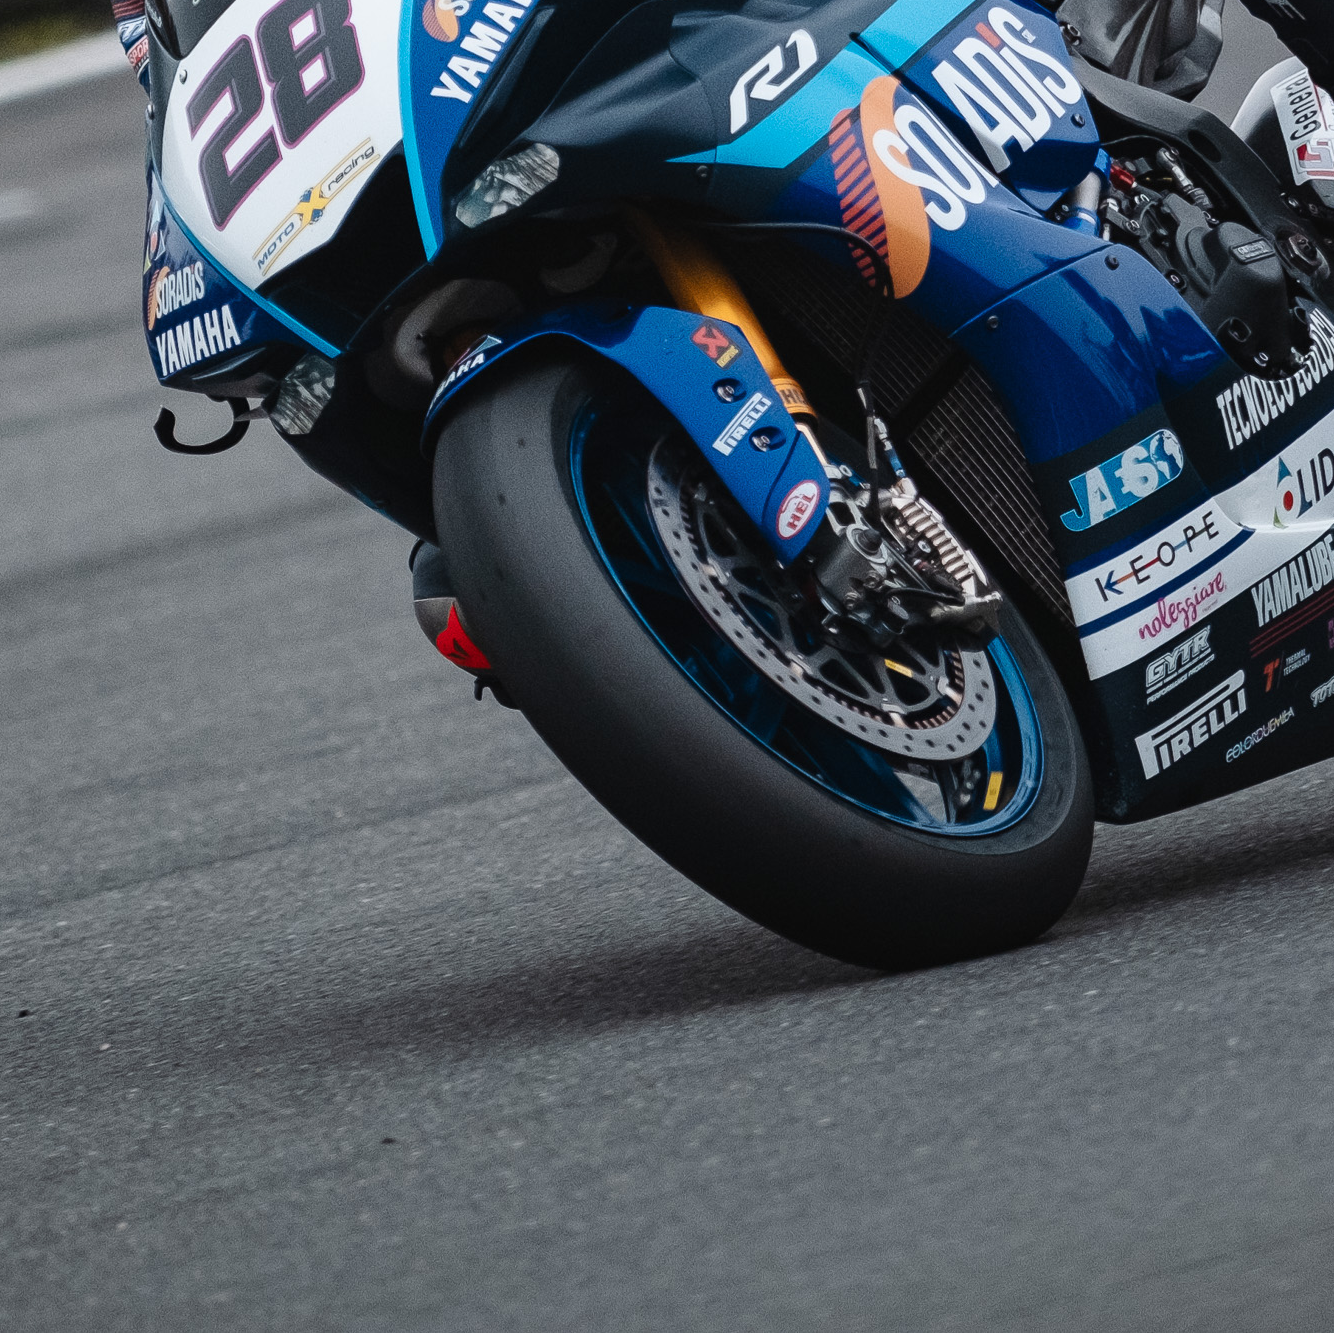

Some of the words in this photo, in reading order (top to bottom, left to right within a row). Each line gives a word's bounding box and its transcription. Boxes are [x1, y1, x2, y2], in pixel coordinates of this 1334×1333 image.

[257, 221, 295, 270] MOTO
[328, 146, 375, 192] racing
[155, 303, 241, 377] YAMAHA
[712, 392, 772, 457] PIRELLI
[786, 492, 816, 531] HEL
[1095, 510, 1220, 602] KEOPE
[1139, 572, 1226, 640] noleggiare
[1145, 624, 1212, 688] GYTR
[1134, 669, 1247, 780] PIRELLI
